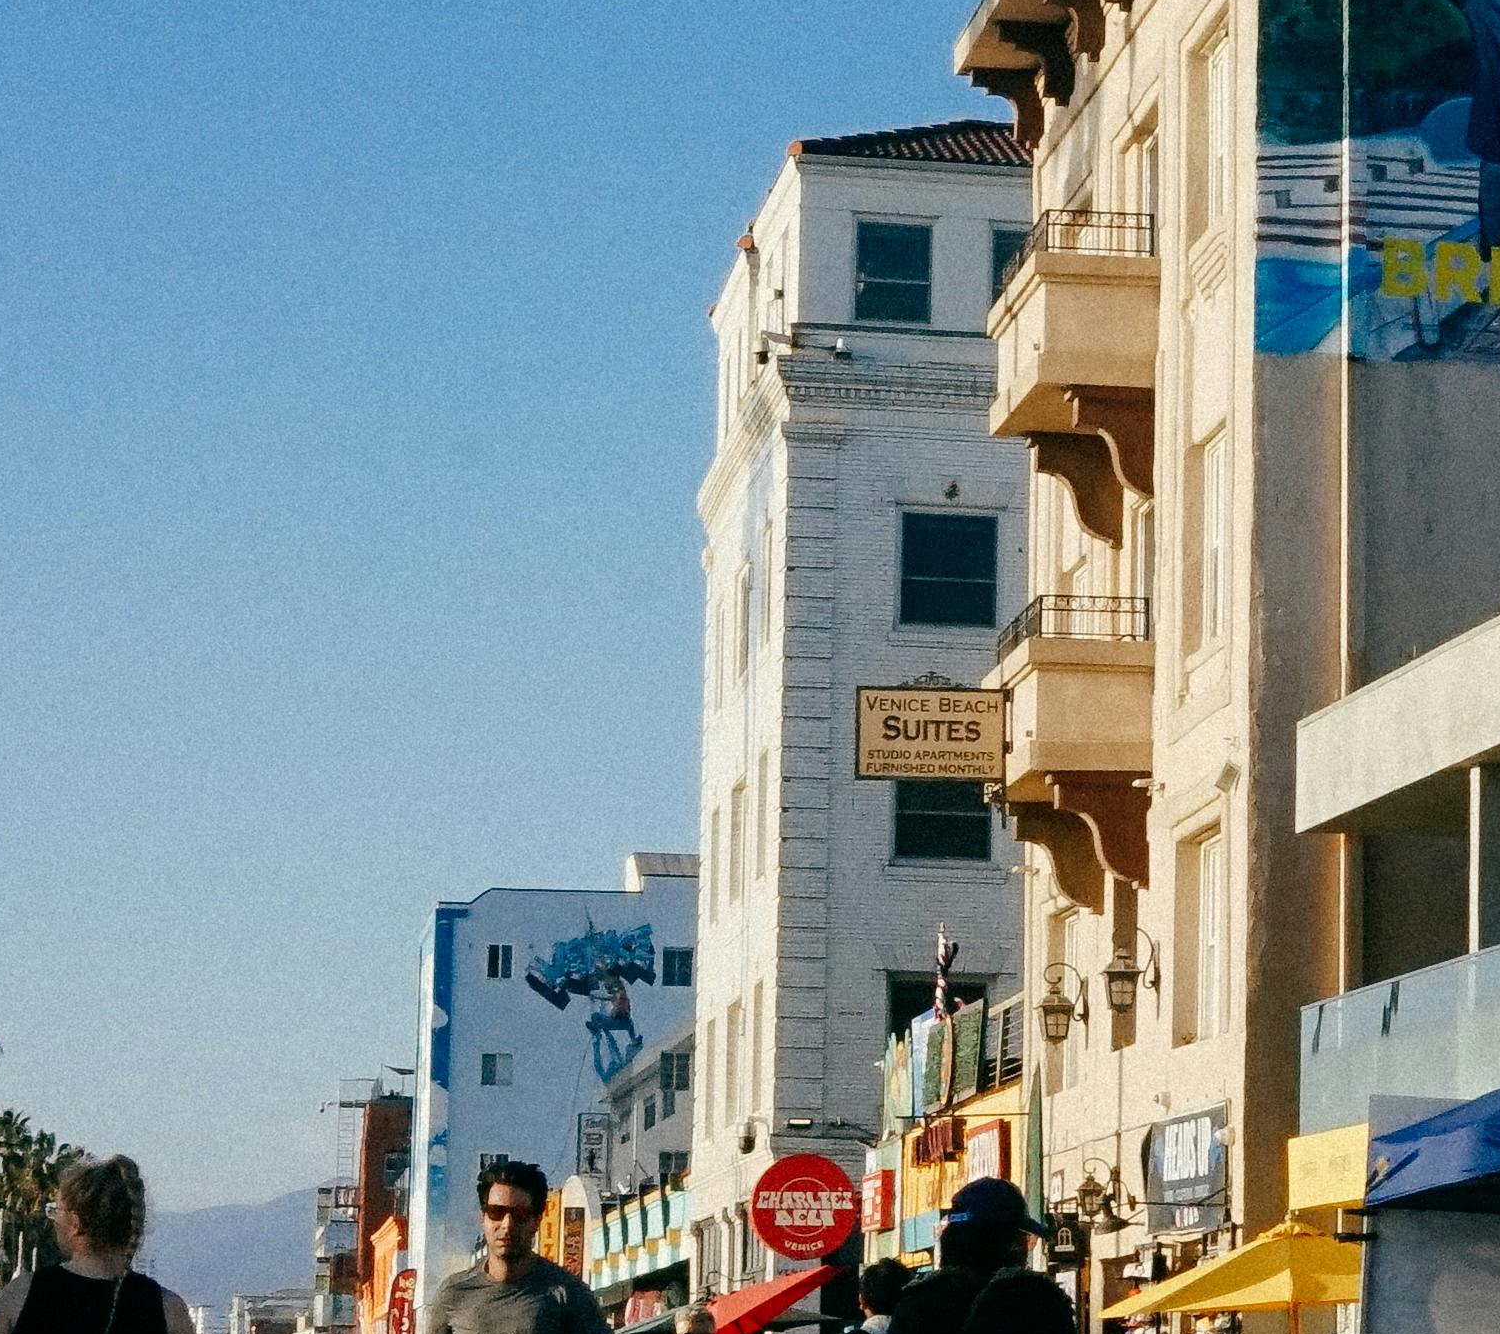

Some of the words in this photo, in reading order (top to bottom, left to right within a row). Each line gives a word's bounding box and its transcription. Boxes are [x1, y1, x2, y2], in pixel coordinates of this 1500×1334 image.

[865, 695, 930, 713] VENICE
[938, 696, 999, 714] BEACH
[882, 714, 981, 742] SUITES
[914, 750, 995, 762] APARTMENTS
[774, 1209, 836, 1227] DELI
[784, 1240, 825, 1253] VENICE
